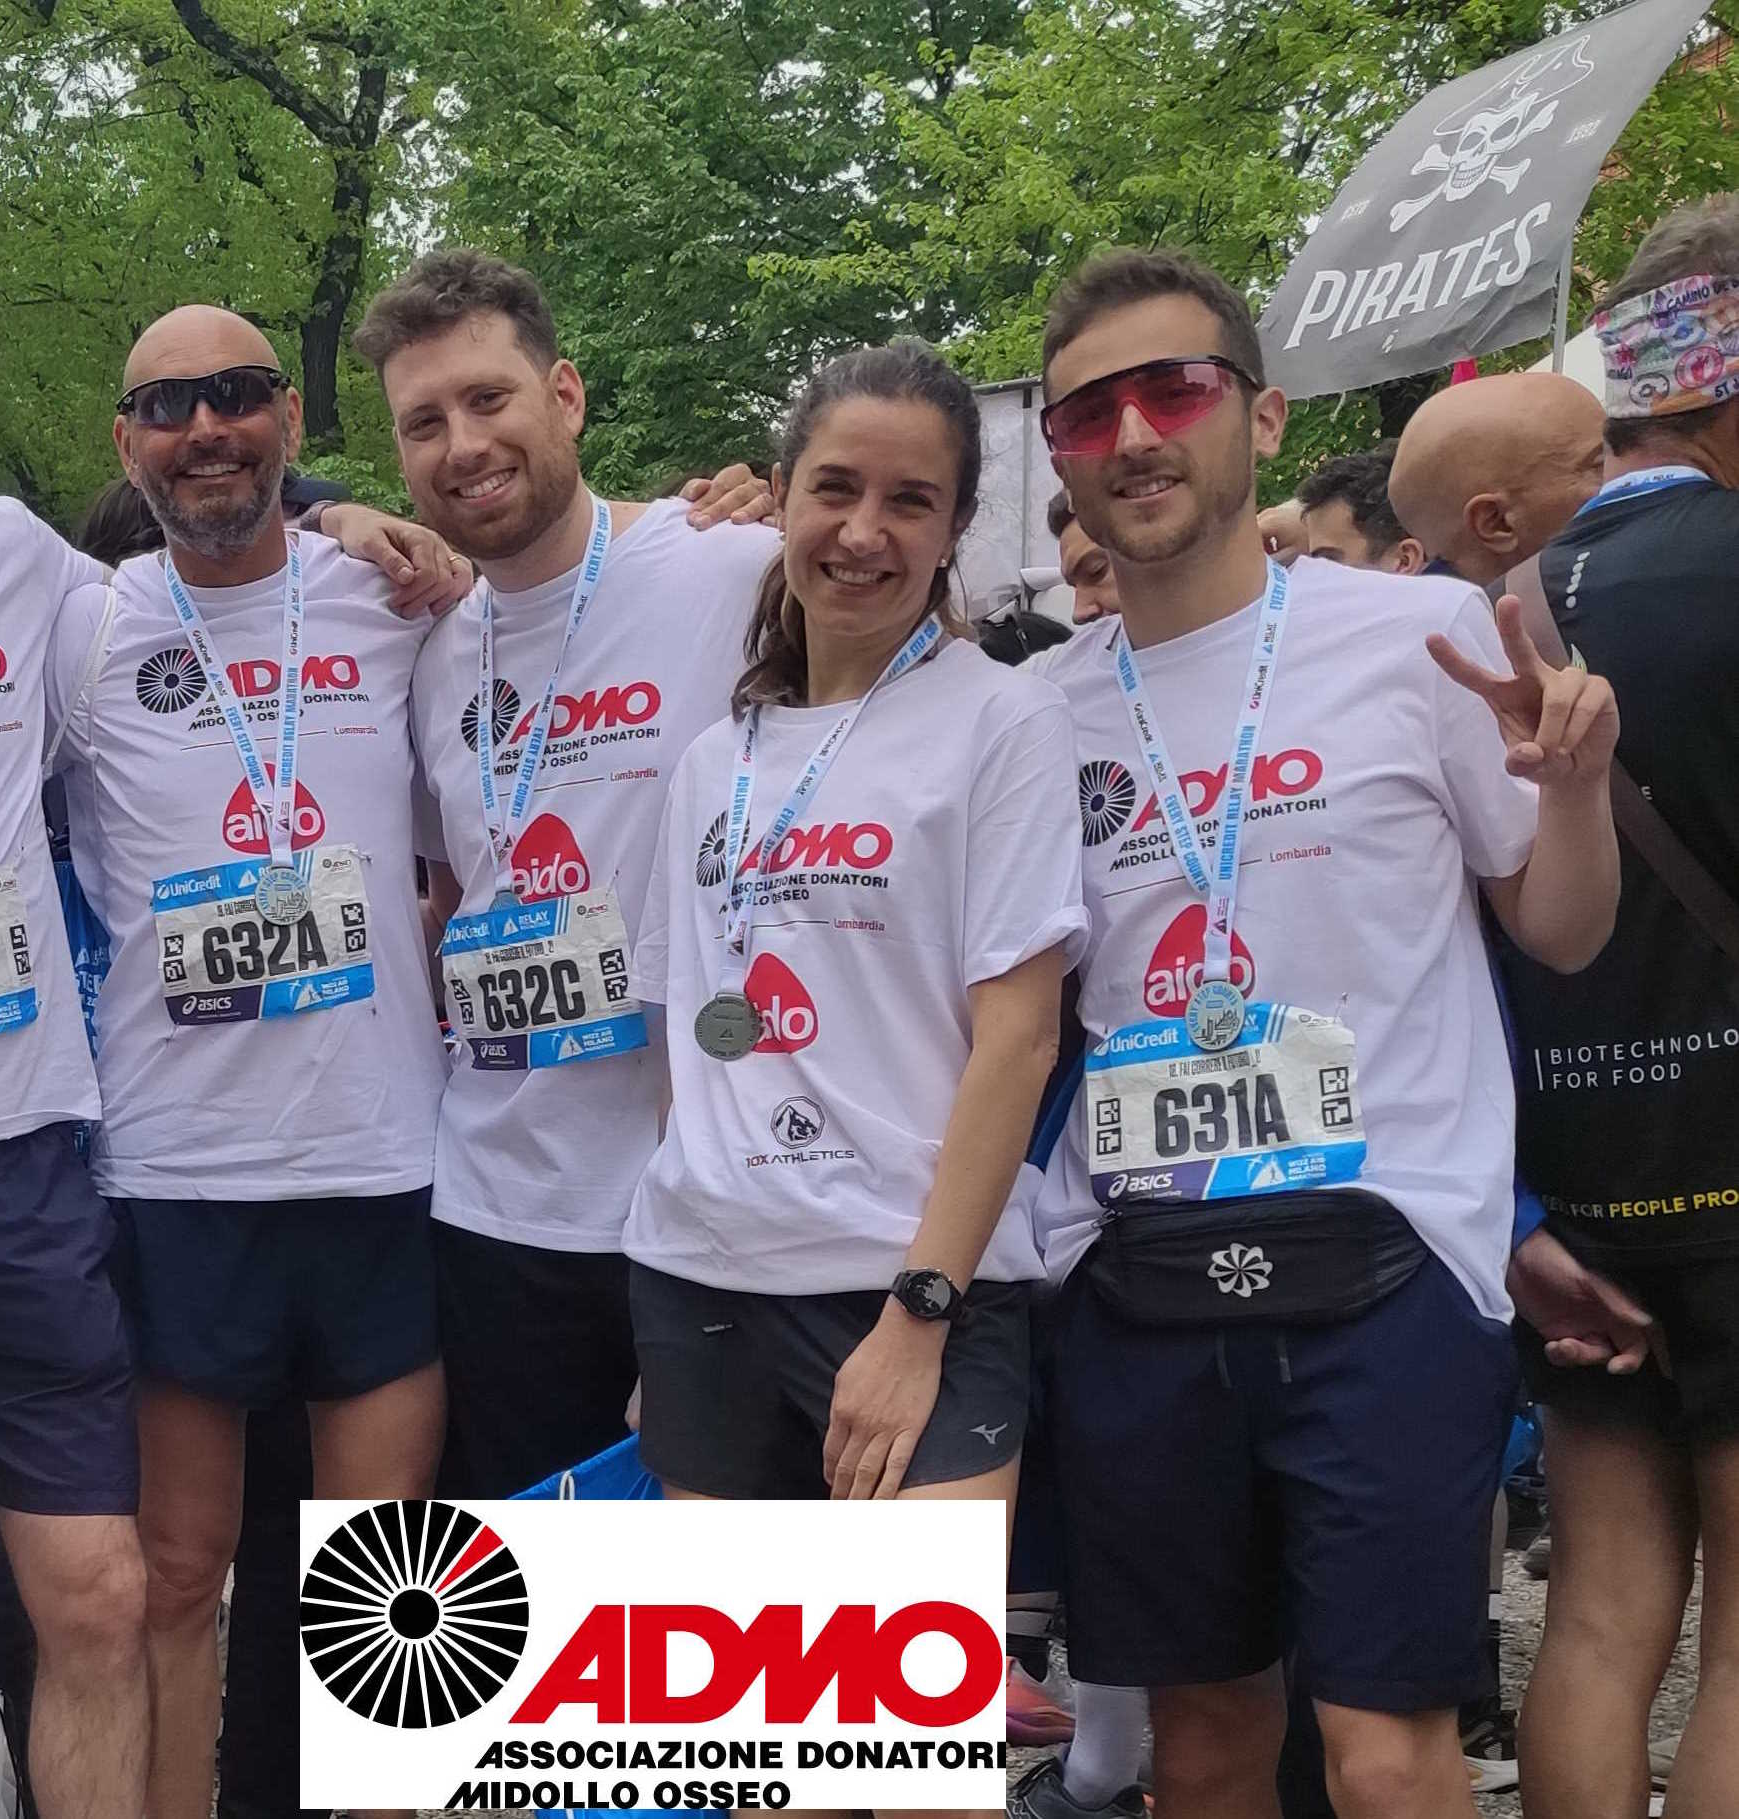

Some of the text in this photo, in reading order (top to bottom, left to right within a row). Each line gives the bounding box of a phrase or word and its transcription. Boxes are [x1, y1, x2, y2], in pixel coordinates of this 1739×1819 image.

[1282, 201, 1552, 351] PIRATES
[591, 529, 607, 554] STEP
[585, 553, 602, 583] EVERY
[1269, 583, 1286, 611] EVERY
[1253, 665, 1268, 699] UniCredit
[304, 693, 369, 705] DONATORI
[509, 681, 661, 745] ADMO
[280, 667, 298, 788] UNICREDIT RELAY MARATHON
[590, 727, 660, 748] DONATORI
[225, 706, 265, 789] EVERY STEP COUNTS
[550, 751, 589, 768] OSSEO
[511, 727, 544, 819] EVERY STEP COUNTS
[480, 774, 495, 810] COUNTS
[731, 775, 751, 828] MARATHON
[1218, 725, 1257, 880] UNICREDIT RELAY MARATHON
[226, 802, 322, 843] aio
[772, 807, 795, 839] EVERY
[1164, 794, 1183, 825] EVERY
[737, 822, 894, 878] ADMO
[1175, 823, 1193, 852] STEP
[1269, 845, 1332, 863] Lombardia
[171, 874, 222, 896] UniCredit
[512, 852, 586, 898] aido
[811, 874, 889, 889] DONATORI
[1183, 850, 1211, 892] COUNTS
[518, 910, 549, 926] RELAY
[202, 910, 329, 985] 632A
[198, 996, 233, 1012] asics
[478, 959, 587, 1032] 632C
[1112, 1029, 1179, 1053] UniCredit
[1550, 1028, 1739, 1065] BIOTECHNOLO
[1552, 1062, 1682, 1090] FOR FOOD
[1154, 1073, 1293, 1158] 631A
[1128, 1172, 1174, 1193] asics
[1571, 1203, 1604, 1218] FOR
[1609, 1197, 1687, 1218] PEOPLE
[1693, 1189, 1739, 1210] PRO
